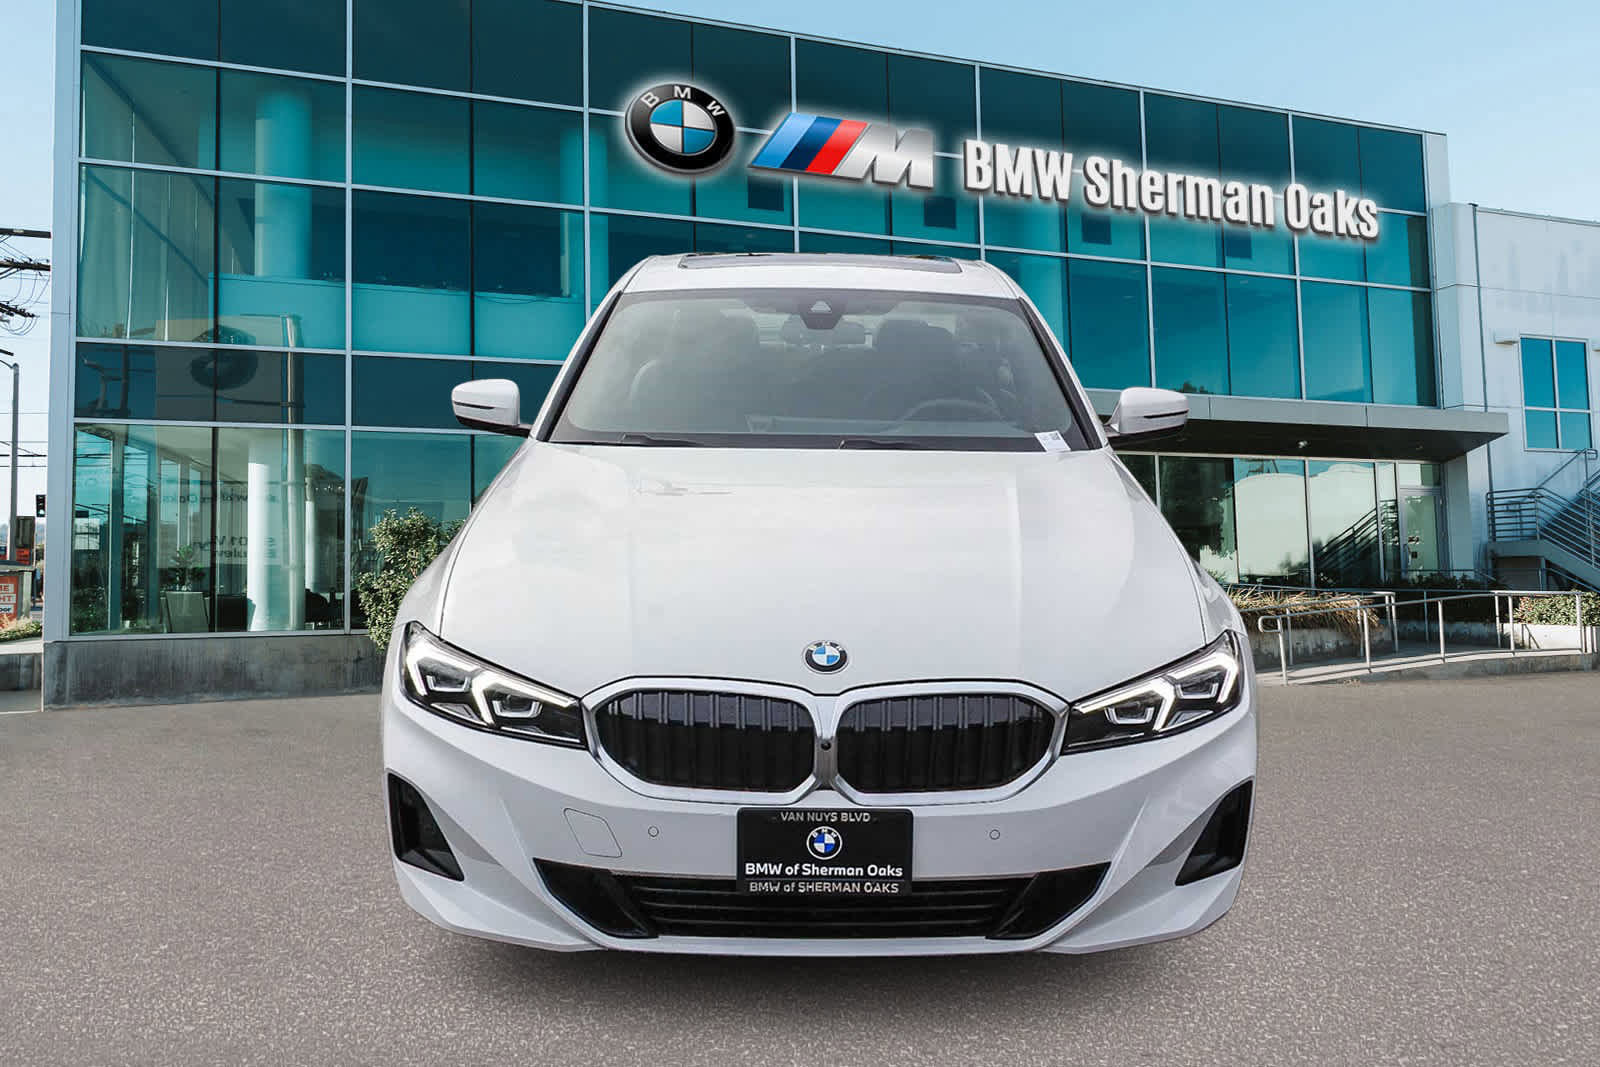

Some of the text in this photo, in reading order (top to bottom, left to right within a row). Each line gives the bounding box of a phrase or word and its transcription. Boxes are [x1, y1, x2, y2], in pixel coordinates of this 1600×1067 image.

[641, 85, 725, 117] BMW
[963, 139, 1379, 240] BMW Sherman Oaks
[780, 811, 871, 822] VAN NUYS BLVD
[745, 863, 903, 877] BMW of Sherman Oaks
[750, 881, 899, 893] BMW of SHERMAN OAKS
